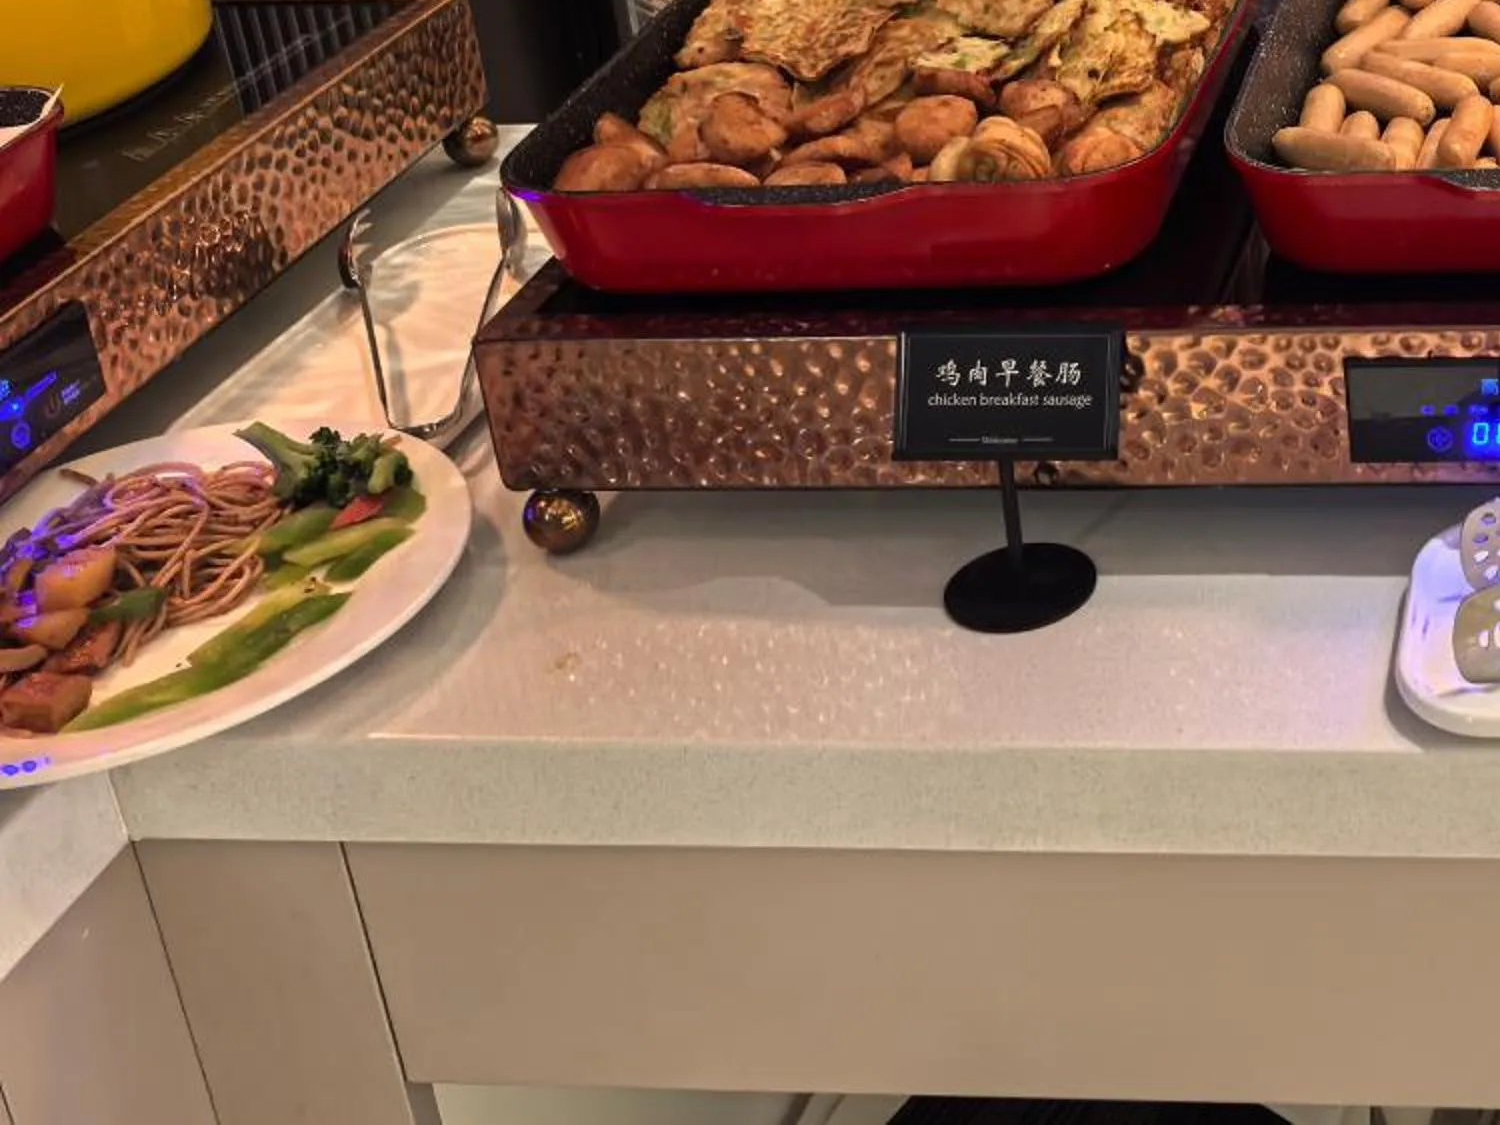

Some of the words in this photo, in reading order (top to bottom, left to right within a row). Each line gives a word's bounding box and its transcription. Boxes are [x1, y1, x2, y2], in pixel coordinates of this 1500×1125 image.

[935, 358, 1082, 388] 鸡肉早餐肠
[927, 392, 977, 407] chicken
[979, 392, 1040, 407] breakfast
[1042, 394, 1093, 410] sausage
